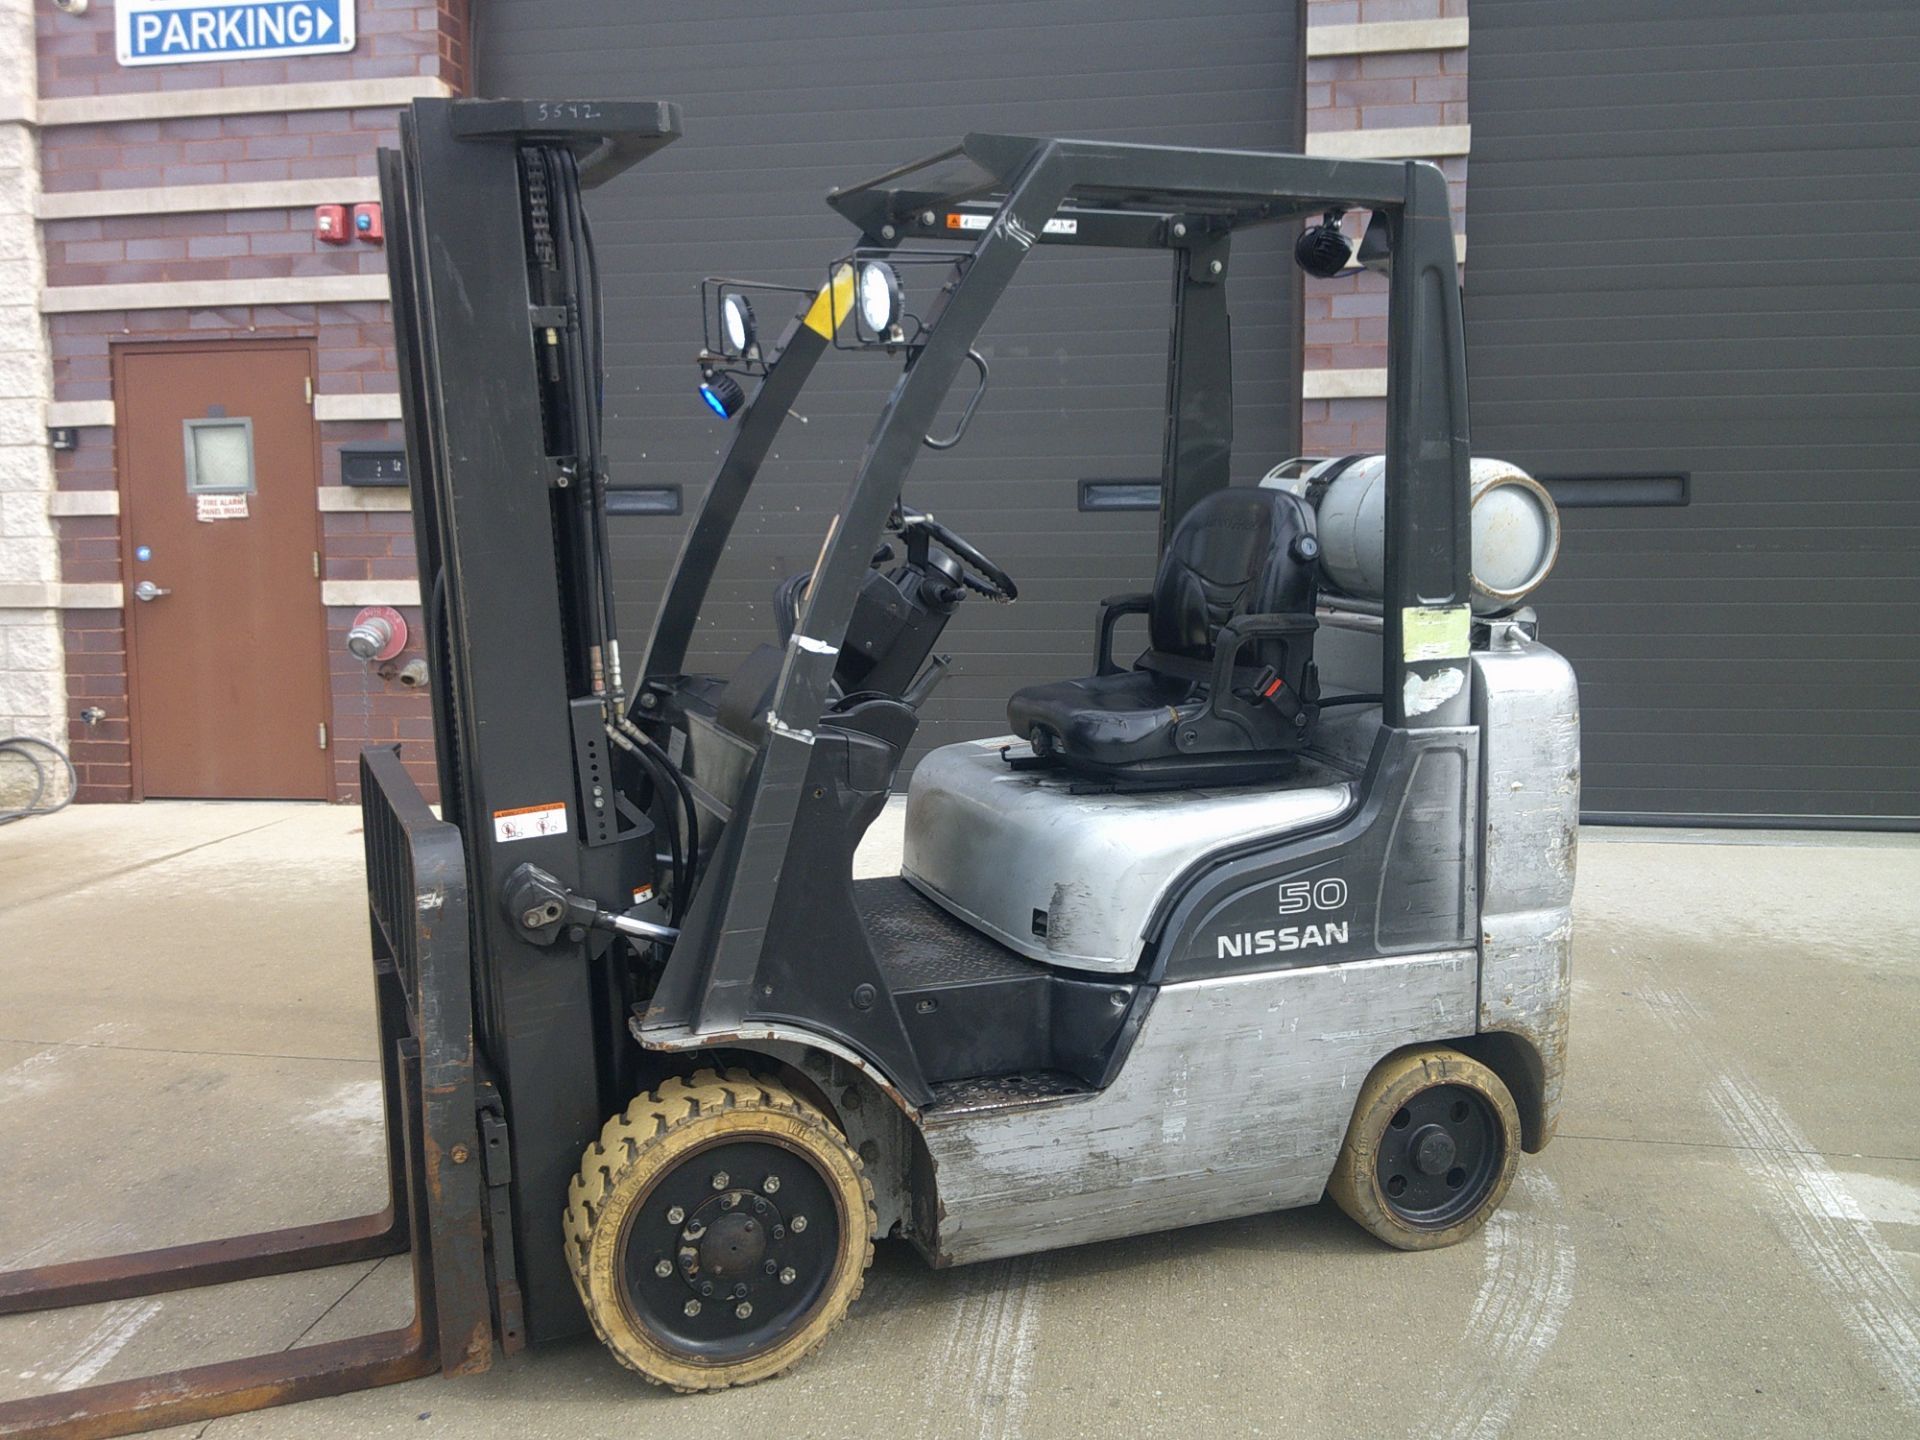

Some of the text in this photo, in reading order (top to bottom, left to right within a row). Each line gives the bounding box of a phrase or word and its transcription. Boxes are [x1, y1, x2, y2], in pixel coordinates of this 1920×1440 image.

[136, 4, 314, 54] PARKING
[201, 506, 246, 515] PANEL INSIDE
[203, 498, 244, 506] FIRE ALARM
[1278, 877, 1348, 915] 50
[1217, 921, 1349, 959] NISSAN
